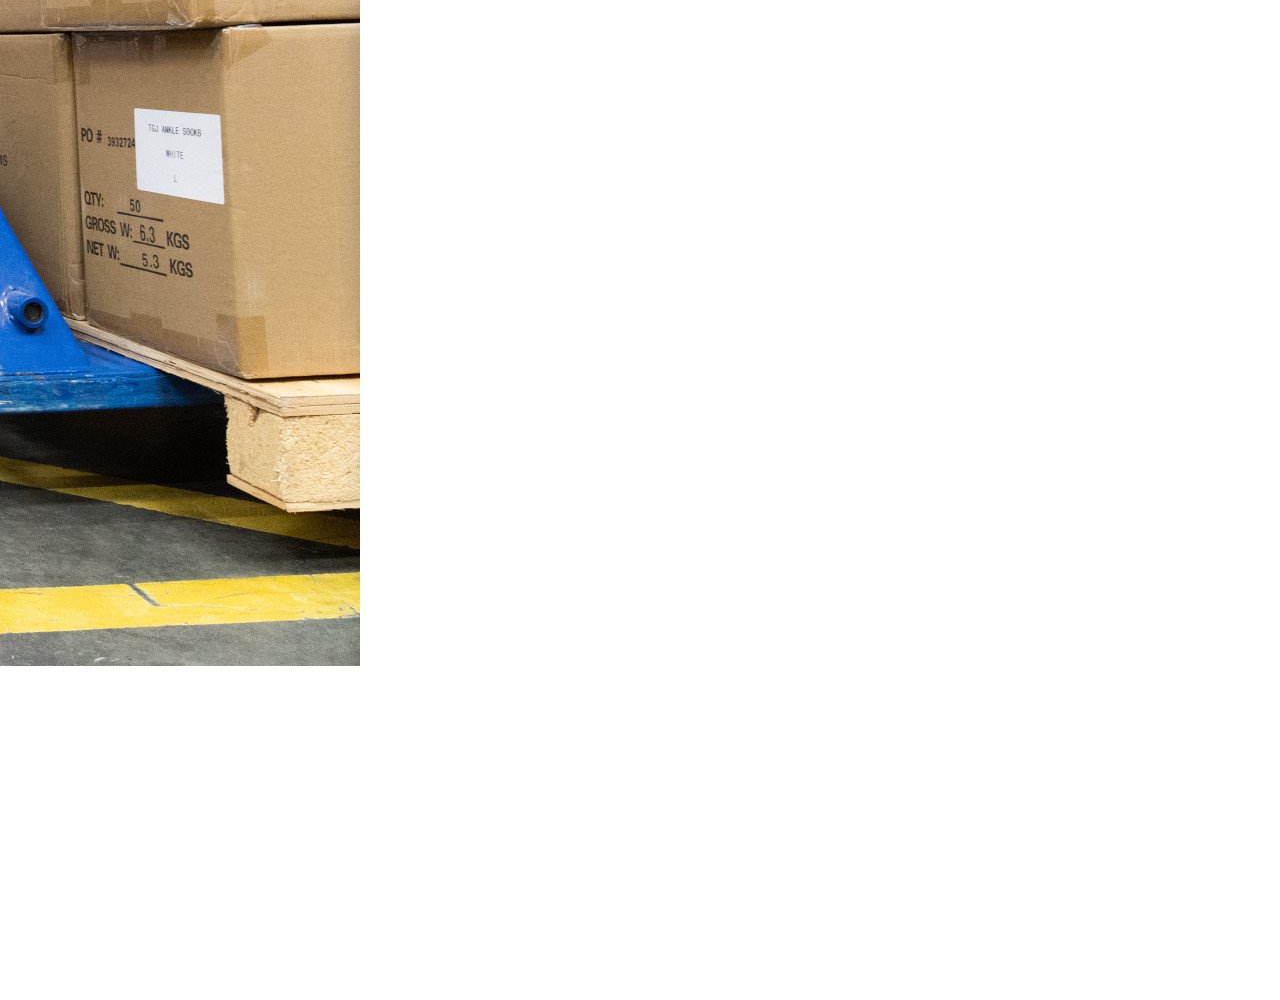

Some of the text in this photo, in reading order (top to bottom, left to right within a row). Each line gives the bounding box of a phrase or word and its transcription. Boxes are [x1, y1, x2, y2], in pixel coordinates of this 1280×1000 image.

[81, 128, 135, 148] PO # 3932724
[161, 126, 179, 135] ANKLE
[182, 127, 202, 137] SOCKS
[165, 150, 184, 160] WHITE
[84, 190, 141, 213] QTY: 50
[85, 215, 190, 250] GROSS W: 6.3 KGS
[86, 239, 194, 278] NET W: 5.3 KGS
